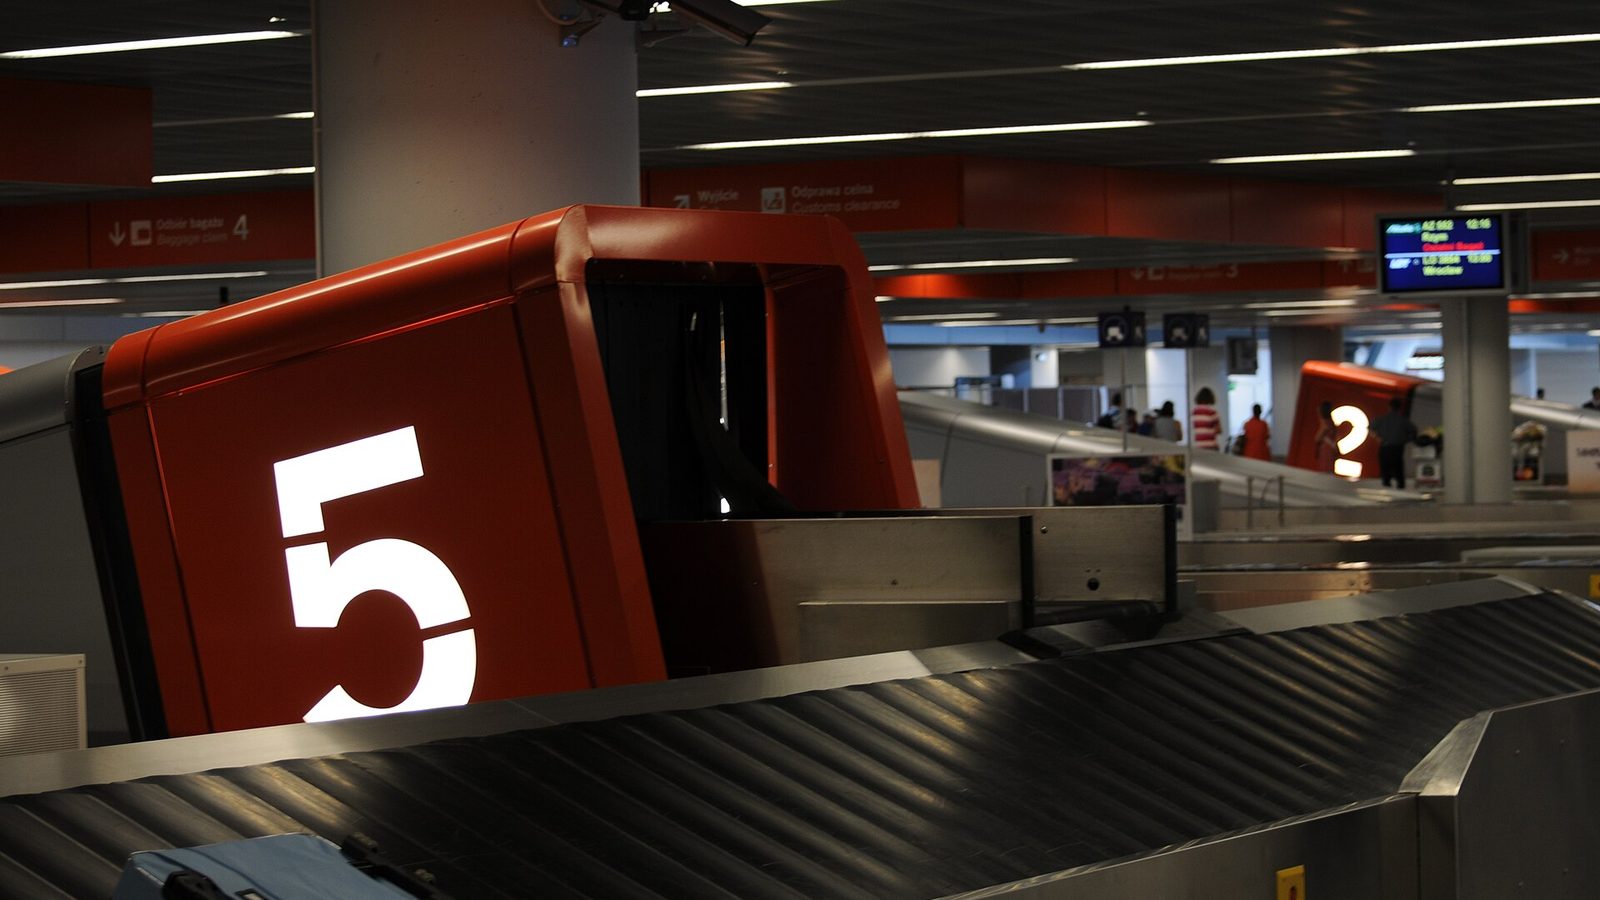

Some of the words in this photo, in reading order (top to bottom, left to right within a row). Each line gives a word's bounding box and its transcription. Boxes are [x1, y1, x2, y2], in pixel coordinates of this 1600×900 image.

[791, 185, 841, 200] Odprawa
[843, 183, 875, 196] celna
[791, 200, 842, 214] Customs
[844, 197, 901, 211] clearance
[232, 213, 249, 240] 4
[157, 234, 201, 247] Baggage
[273, 425, 477, 724] 5
